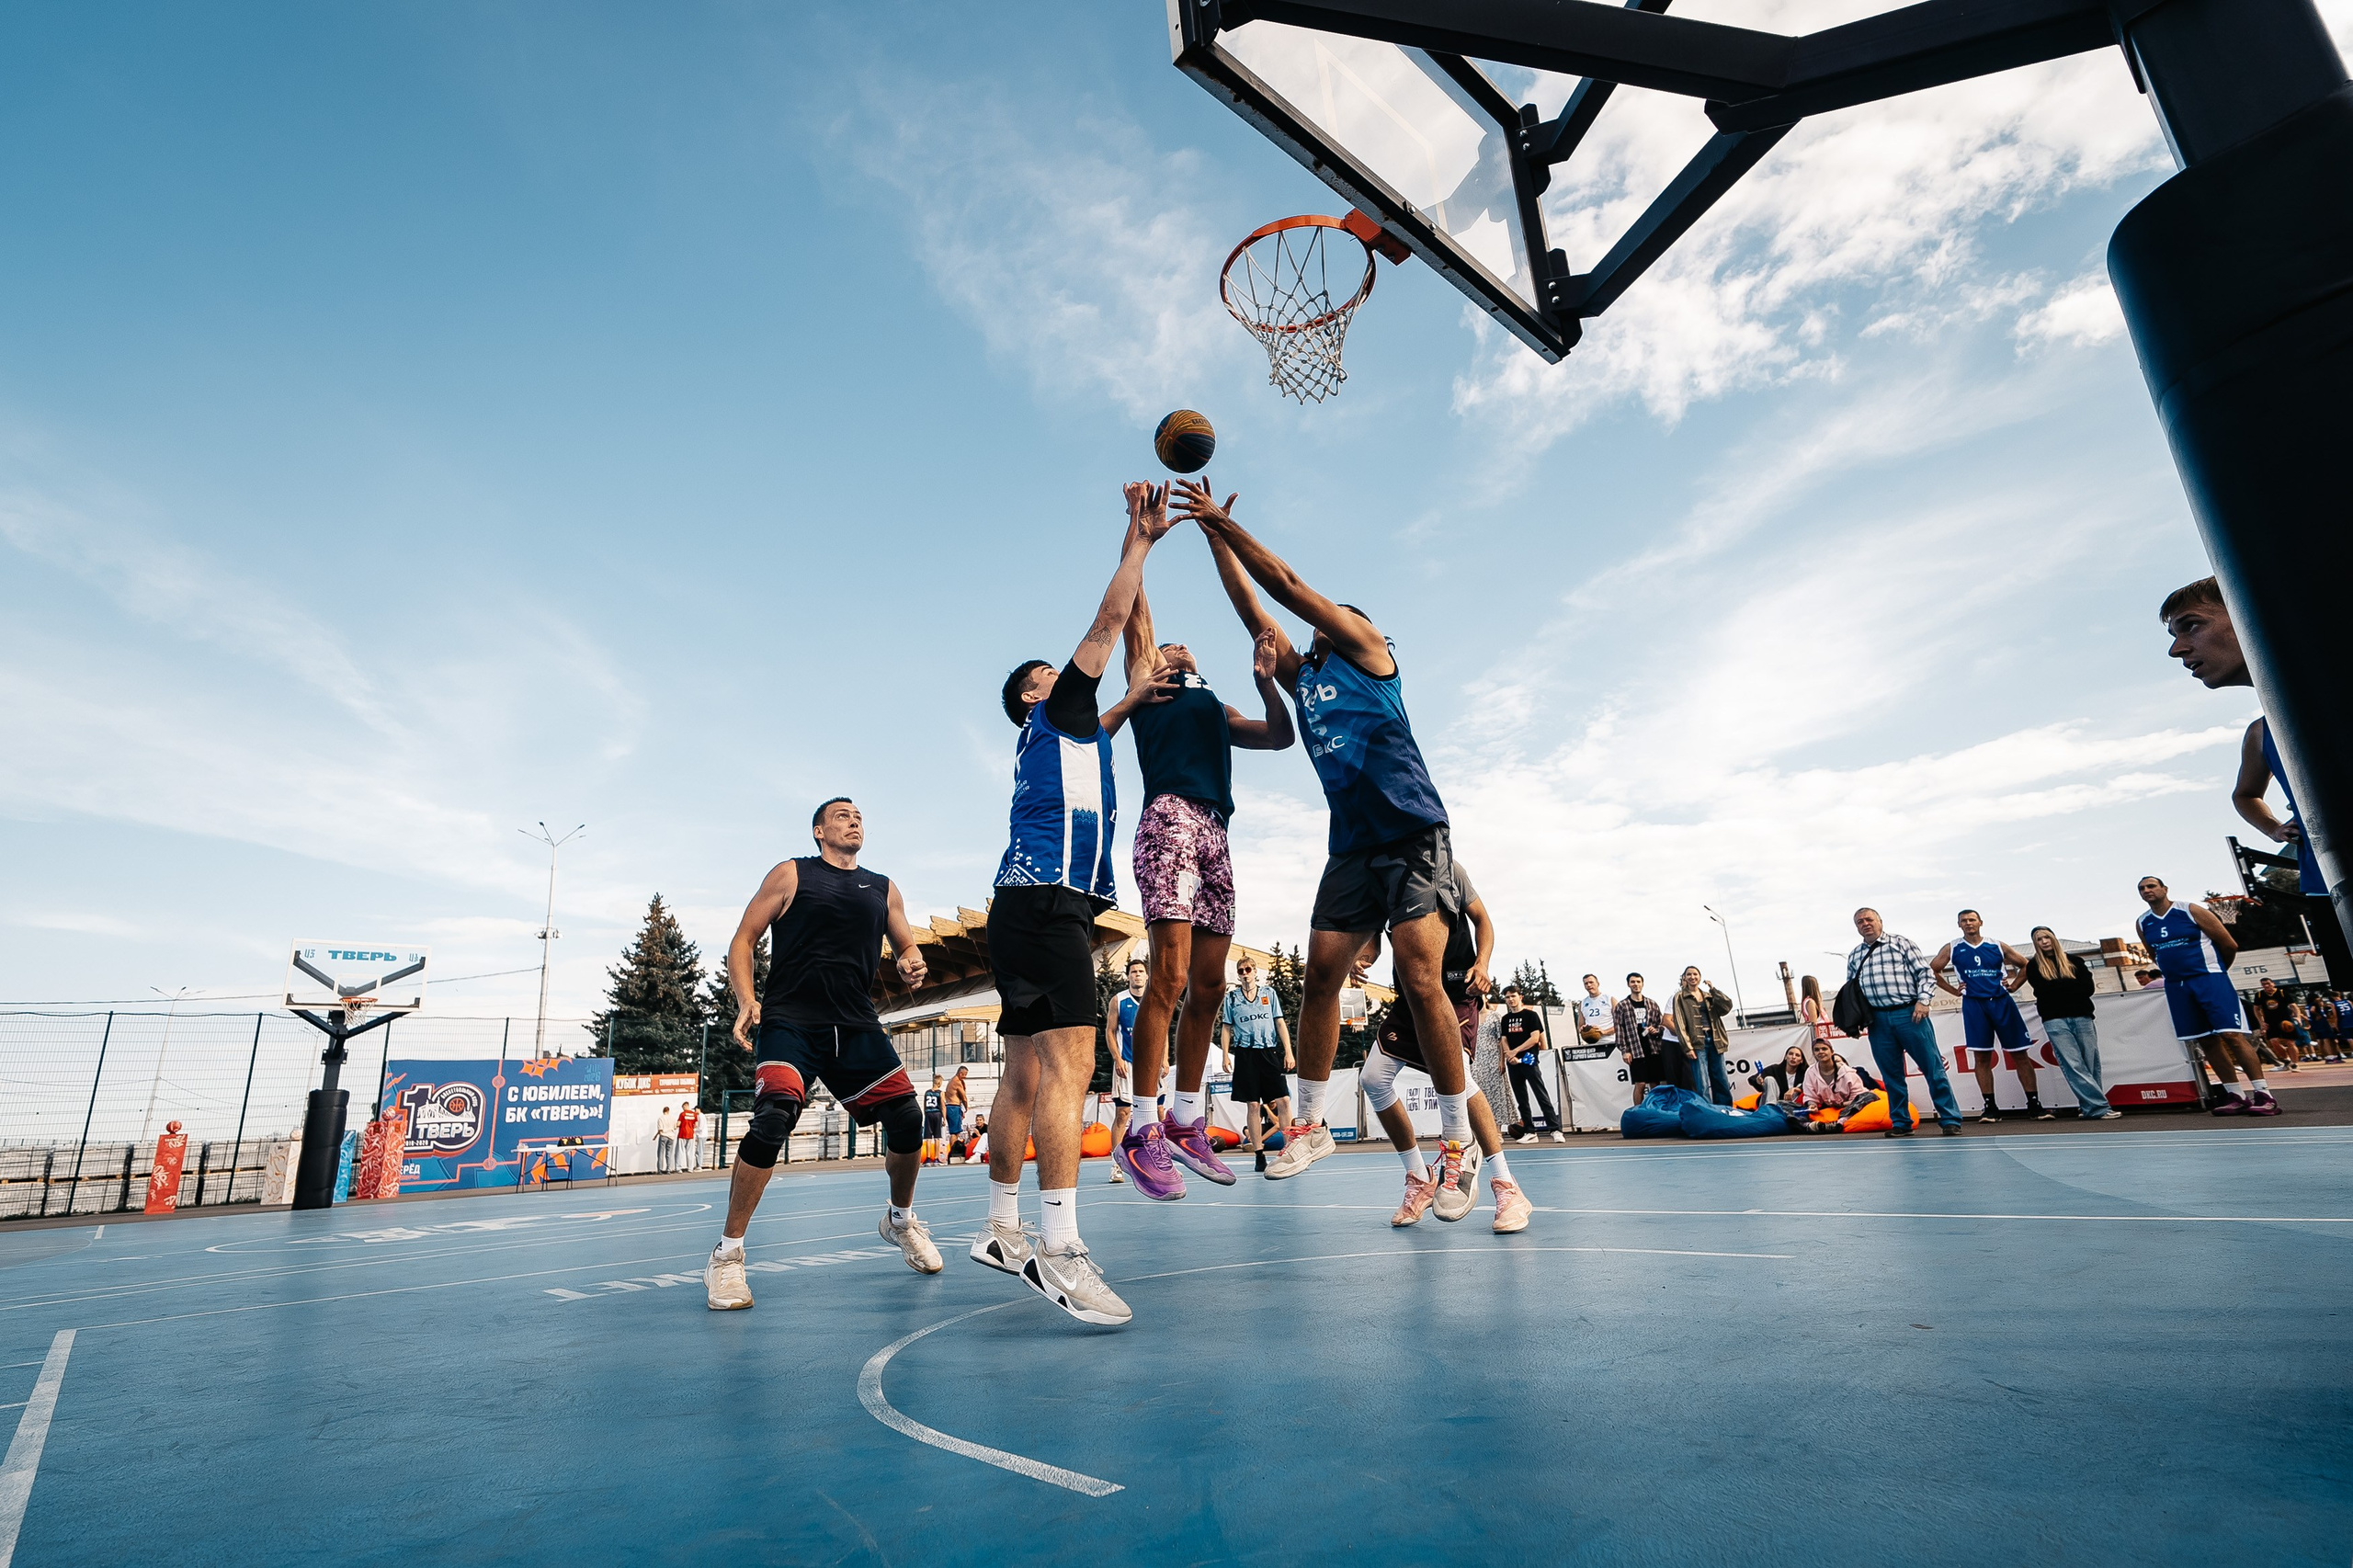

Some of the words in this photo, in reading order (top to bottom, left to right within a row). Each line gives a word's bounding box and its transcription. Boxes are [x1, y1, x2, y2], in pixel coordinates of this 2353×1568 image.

[2161, 926, 2168, 937] 5
[327, 949, 397, 961] ТВЕРЬ
[1974, 956, 1982, 966] 9
[2244, 965, 2268, 975] ВТБ
[1588, 1008, 1600, 1017] 23
[2336, 1003, 2350, 1011] 35
[1250, 1012, 1269, 1021] DKC
[2234, 1013, 2241, 1026] 5
[615, 1077, 637, 1090] КУБОК
[507, 1086, 519, 1102] С
[522, 1085, 605, 1102] ЮБИЛЕЕМ,
[1424, 1086, 1438, 1098] ТВЕ
[2141, 1089, 2167, 1100] DKC.RU
[926, 1096, 938, 1108] 23
[1424, 1099, 1438, 1110] УЛИ
[506, 1107, 528, 1123] БК
[530, 1104, 604, 1122] «ТВЕРЬ»!
[415, 1121, 475, 1139] ТВЕРЬ
[400, 1163, 421, 1175] ЕРЁД
